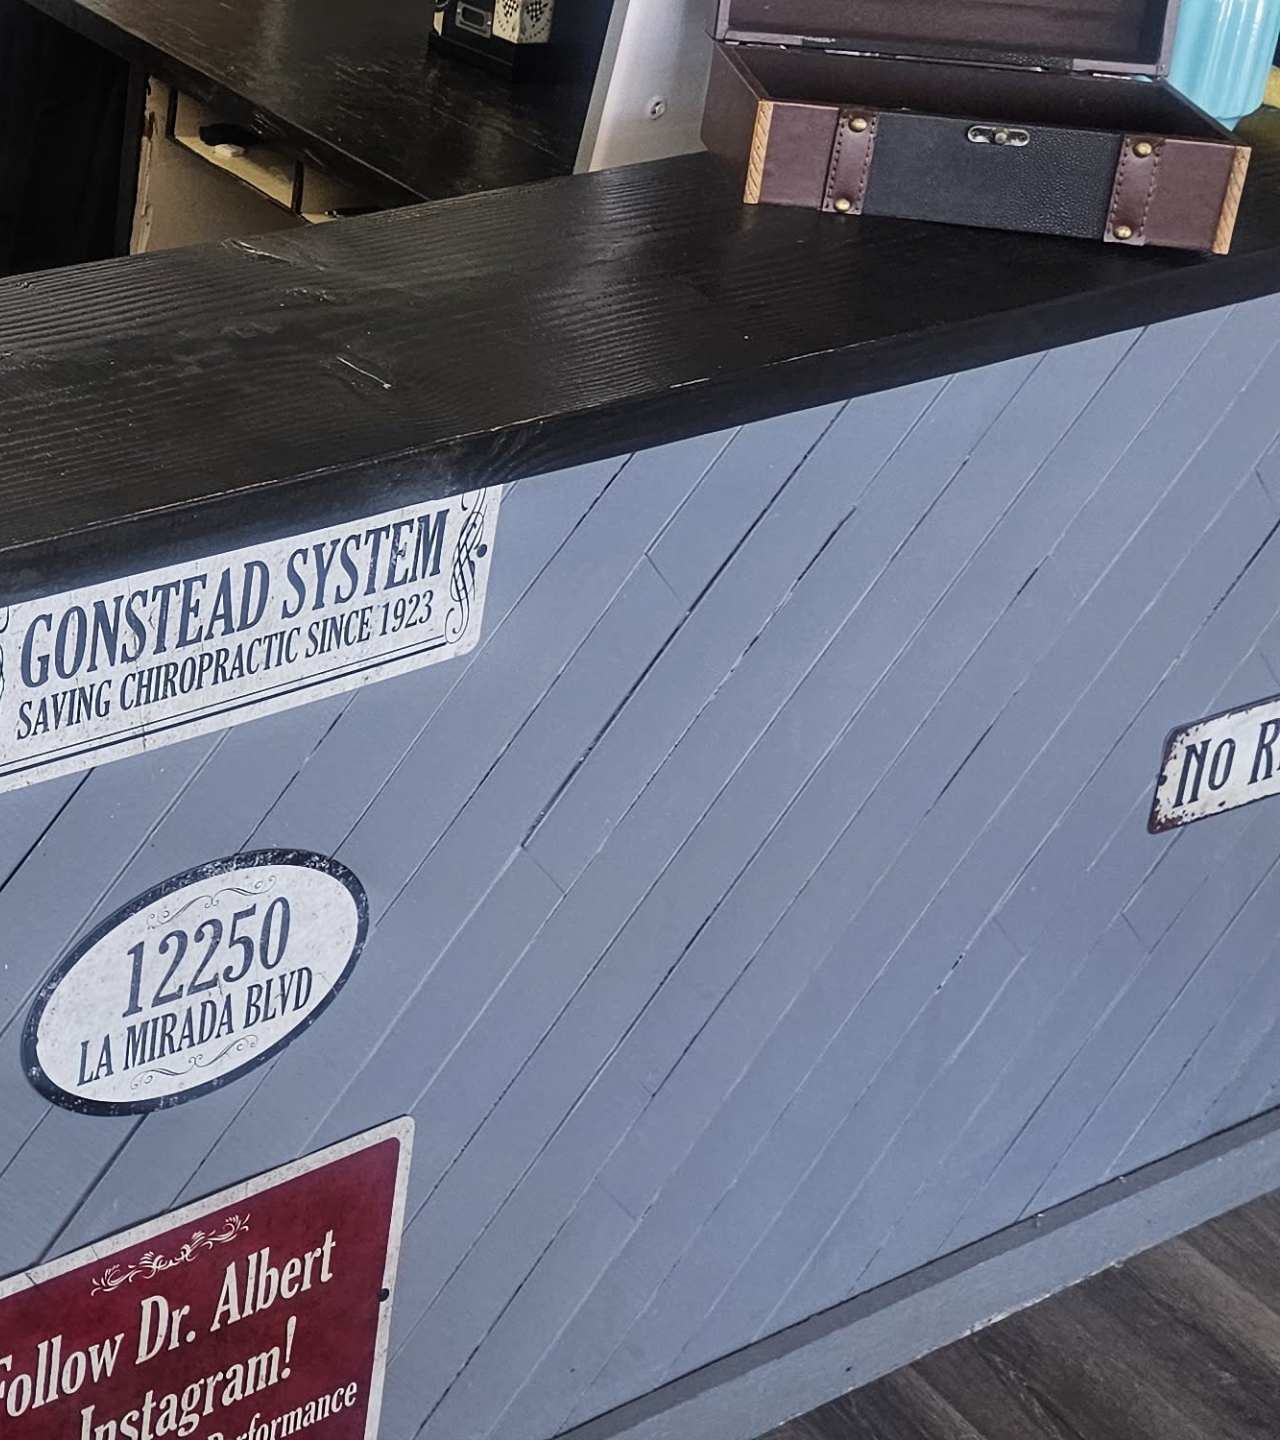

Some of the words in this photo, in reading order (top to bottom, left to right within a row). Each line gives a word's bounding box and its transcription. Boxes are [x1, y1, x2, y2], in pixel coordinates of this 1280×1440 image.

[20, 560, 270, 688] GONSTEAD
[280, 508, 450, 620] SYSTEM
[16, 680, 114, 740] SAVING
[119, 632, 301, 711] CHIROPRACTIC
[306, 606, 371, 661] SINCE
[378, 588, 434, 637] 1923
[1173, 738, 1236, 808] NO
[122, 896, 290, 1018] 12250
[77, 1039, 116, 1086] LA
[123, 996, 235, 1072] MIRADA
[244, 967, 313, 1028] BLVD
[135, 1295, 197, 1365] Dr.
[210, 1229, 338, 1332] Albert
[80, 1315, 297, 1440] Instagram!
